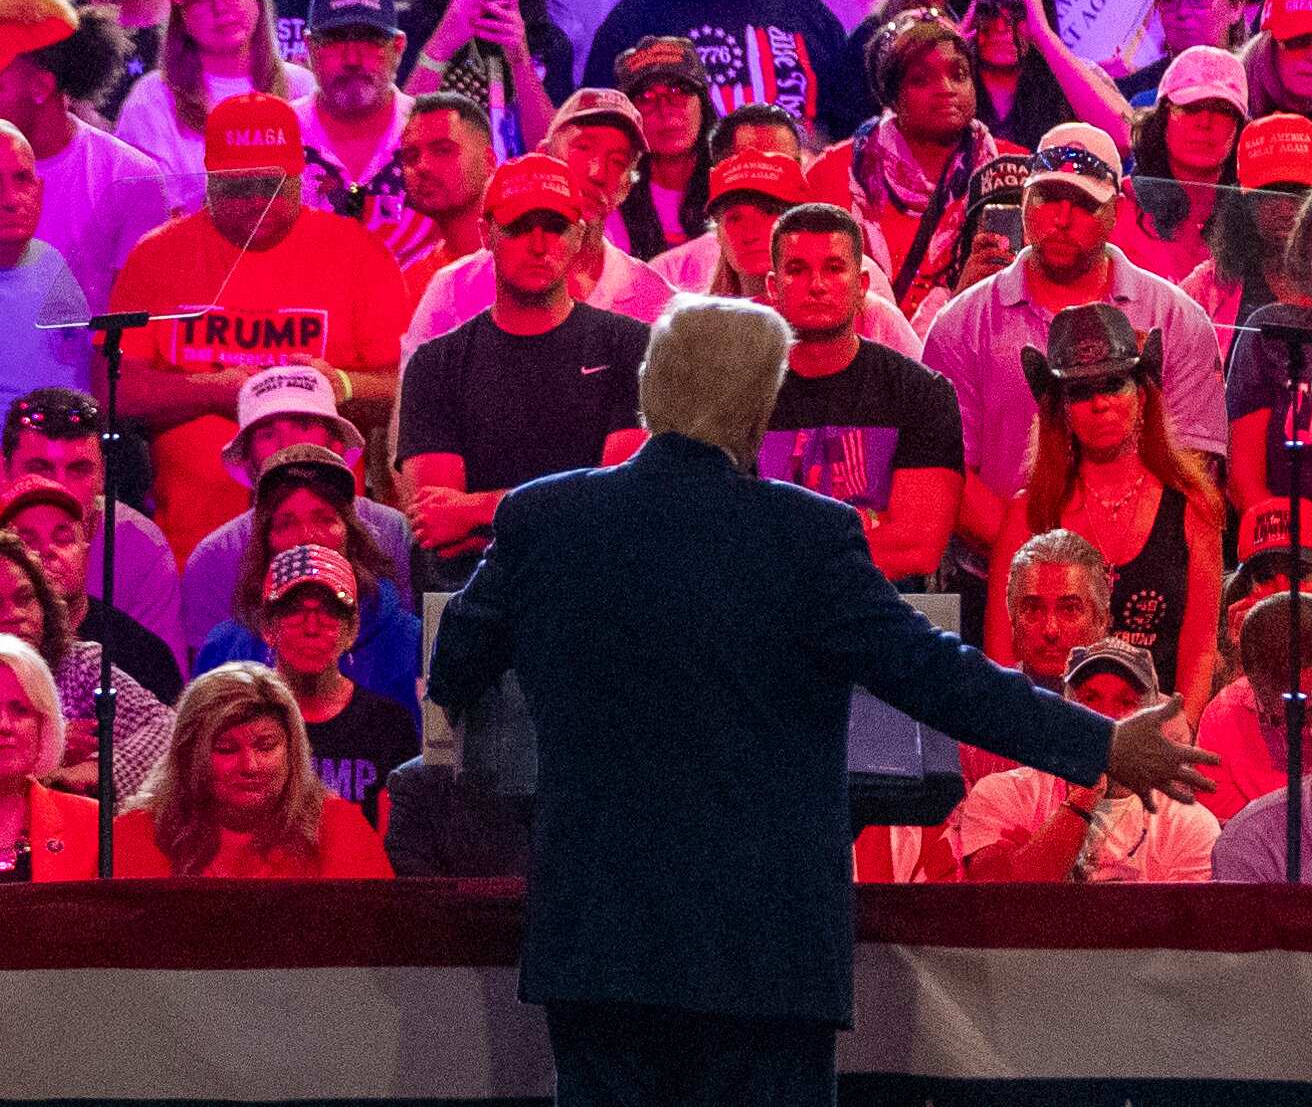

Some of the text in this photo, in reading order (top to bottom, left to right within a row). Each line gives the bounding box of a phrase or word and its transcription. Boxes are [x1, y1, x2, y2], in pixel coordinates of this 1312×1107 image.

[695, 44, 732, 67] 776
[981, 160, 1029, 184] ULTRA
[980, 173, 1030, 198] MAGA
[177, 313, 322, 350] TRUMP
